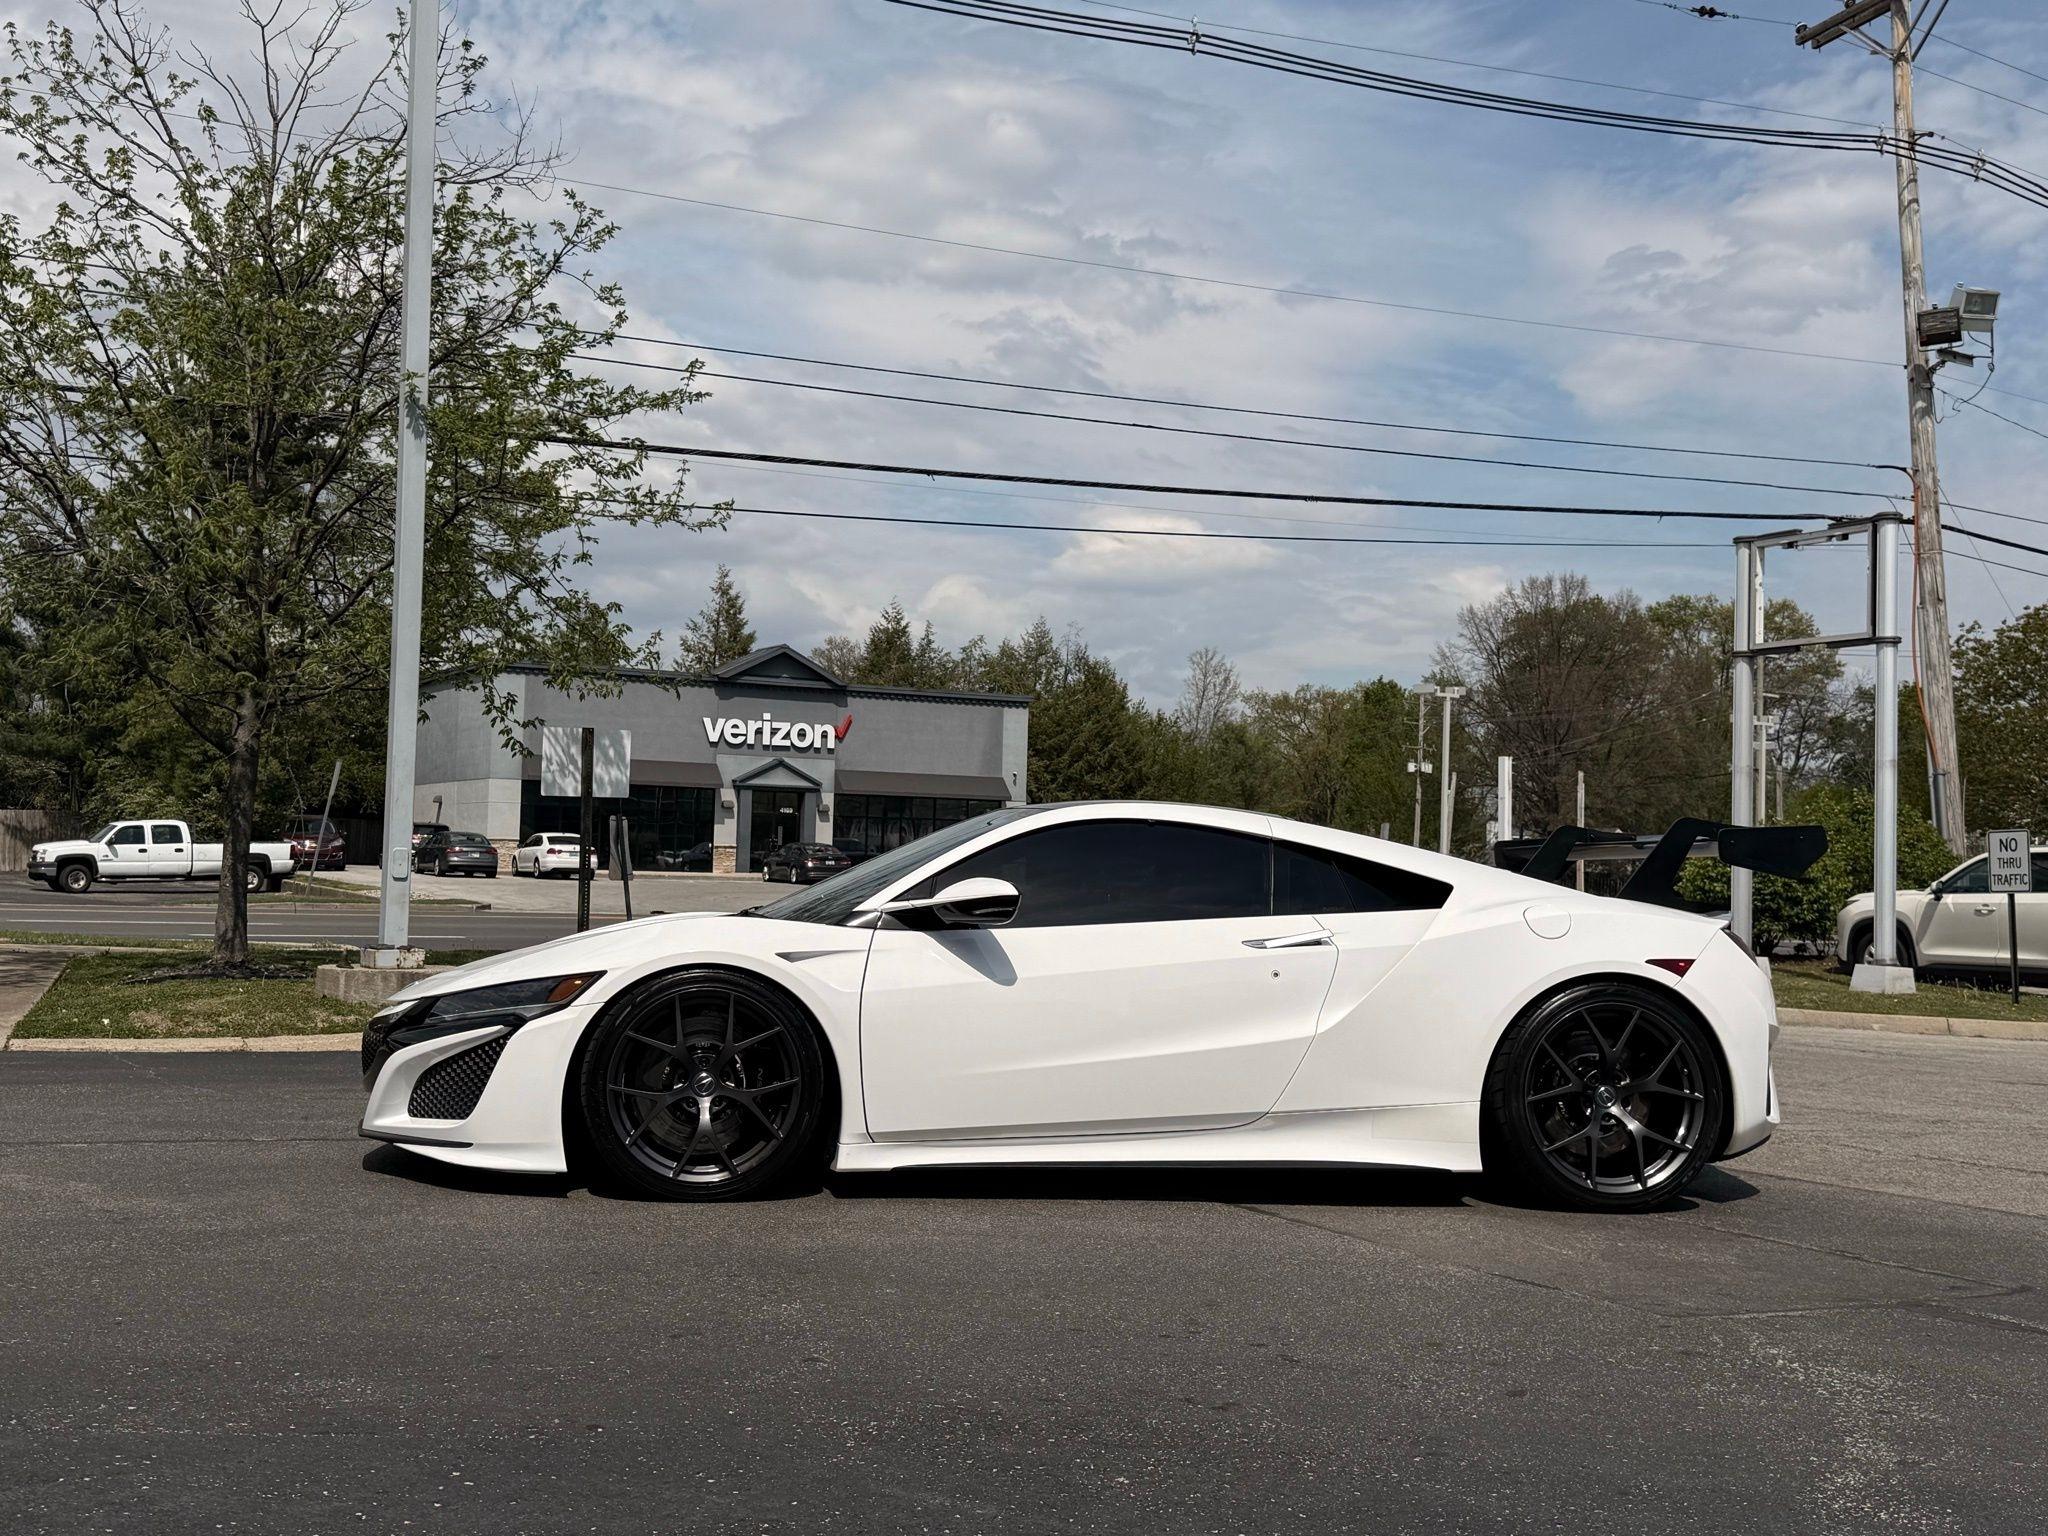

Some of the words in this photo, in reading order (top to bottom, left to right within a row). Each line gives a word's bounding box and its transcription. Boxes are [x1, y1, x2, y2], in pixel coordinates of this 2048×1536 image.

[702, 712, 836, 750] verizon
[1999, 837, 2018, 852] NO
[1997, 857, 2022, 869] THRU
[1992, 873, 2028, 887] TRAFFIC
